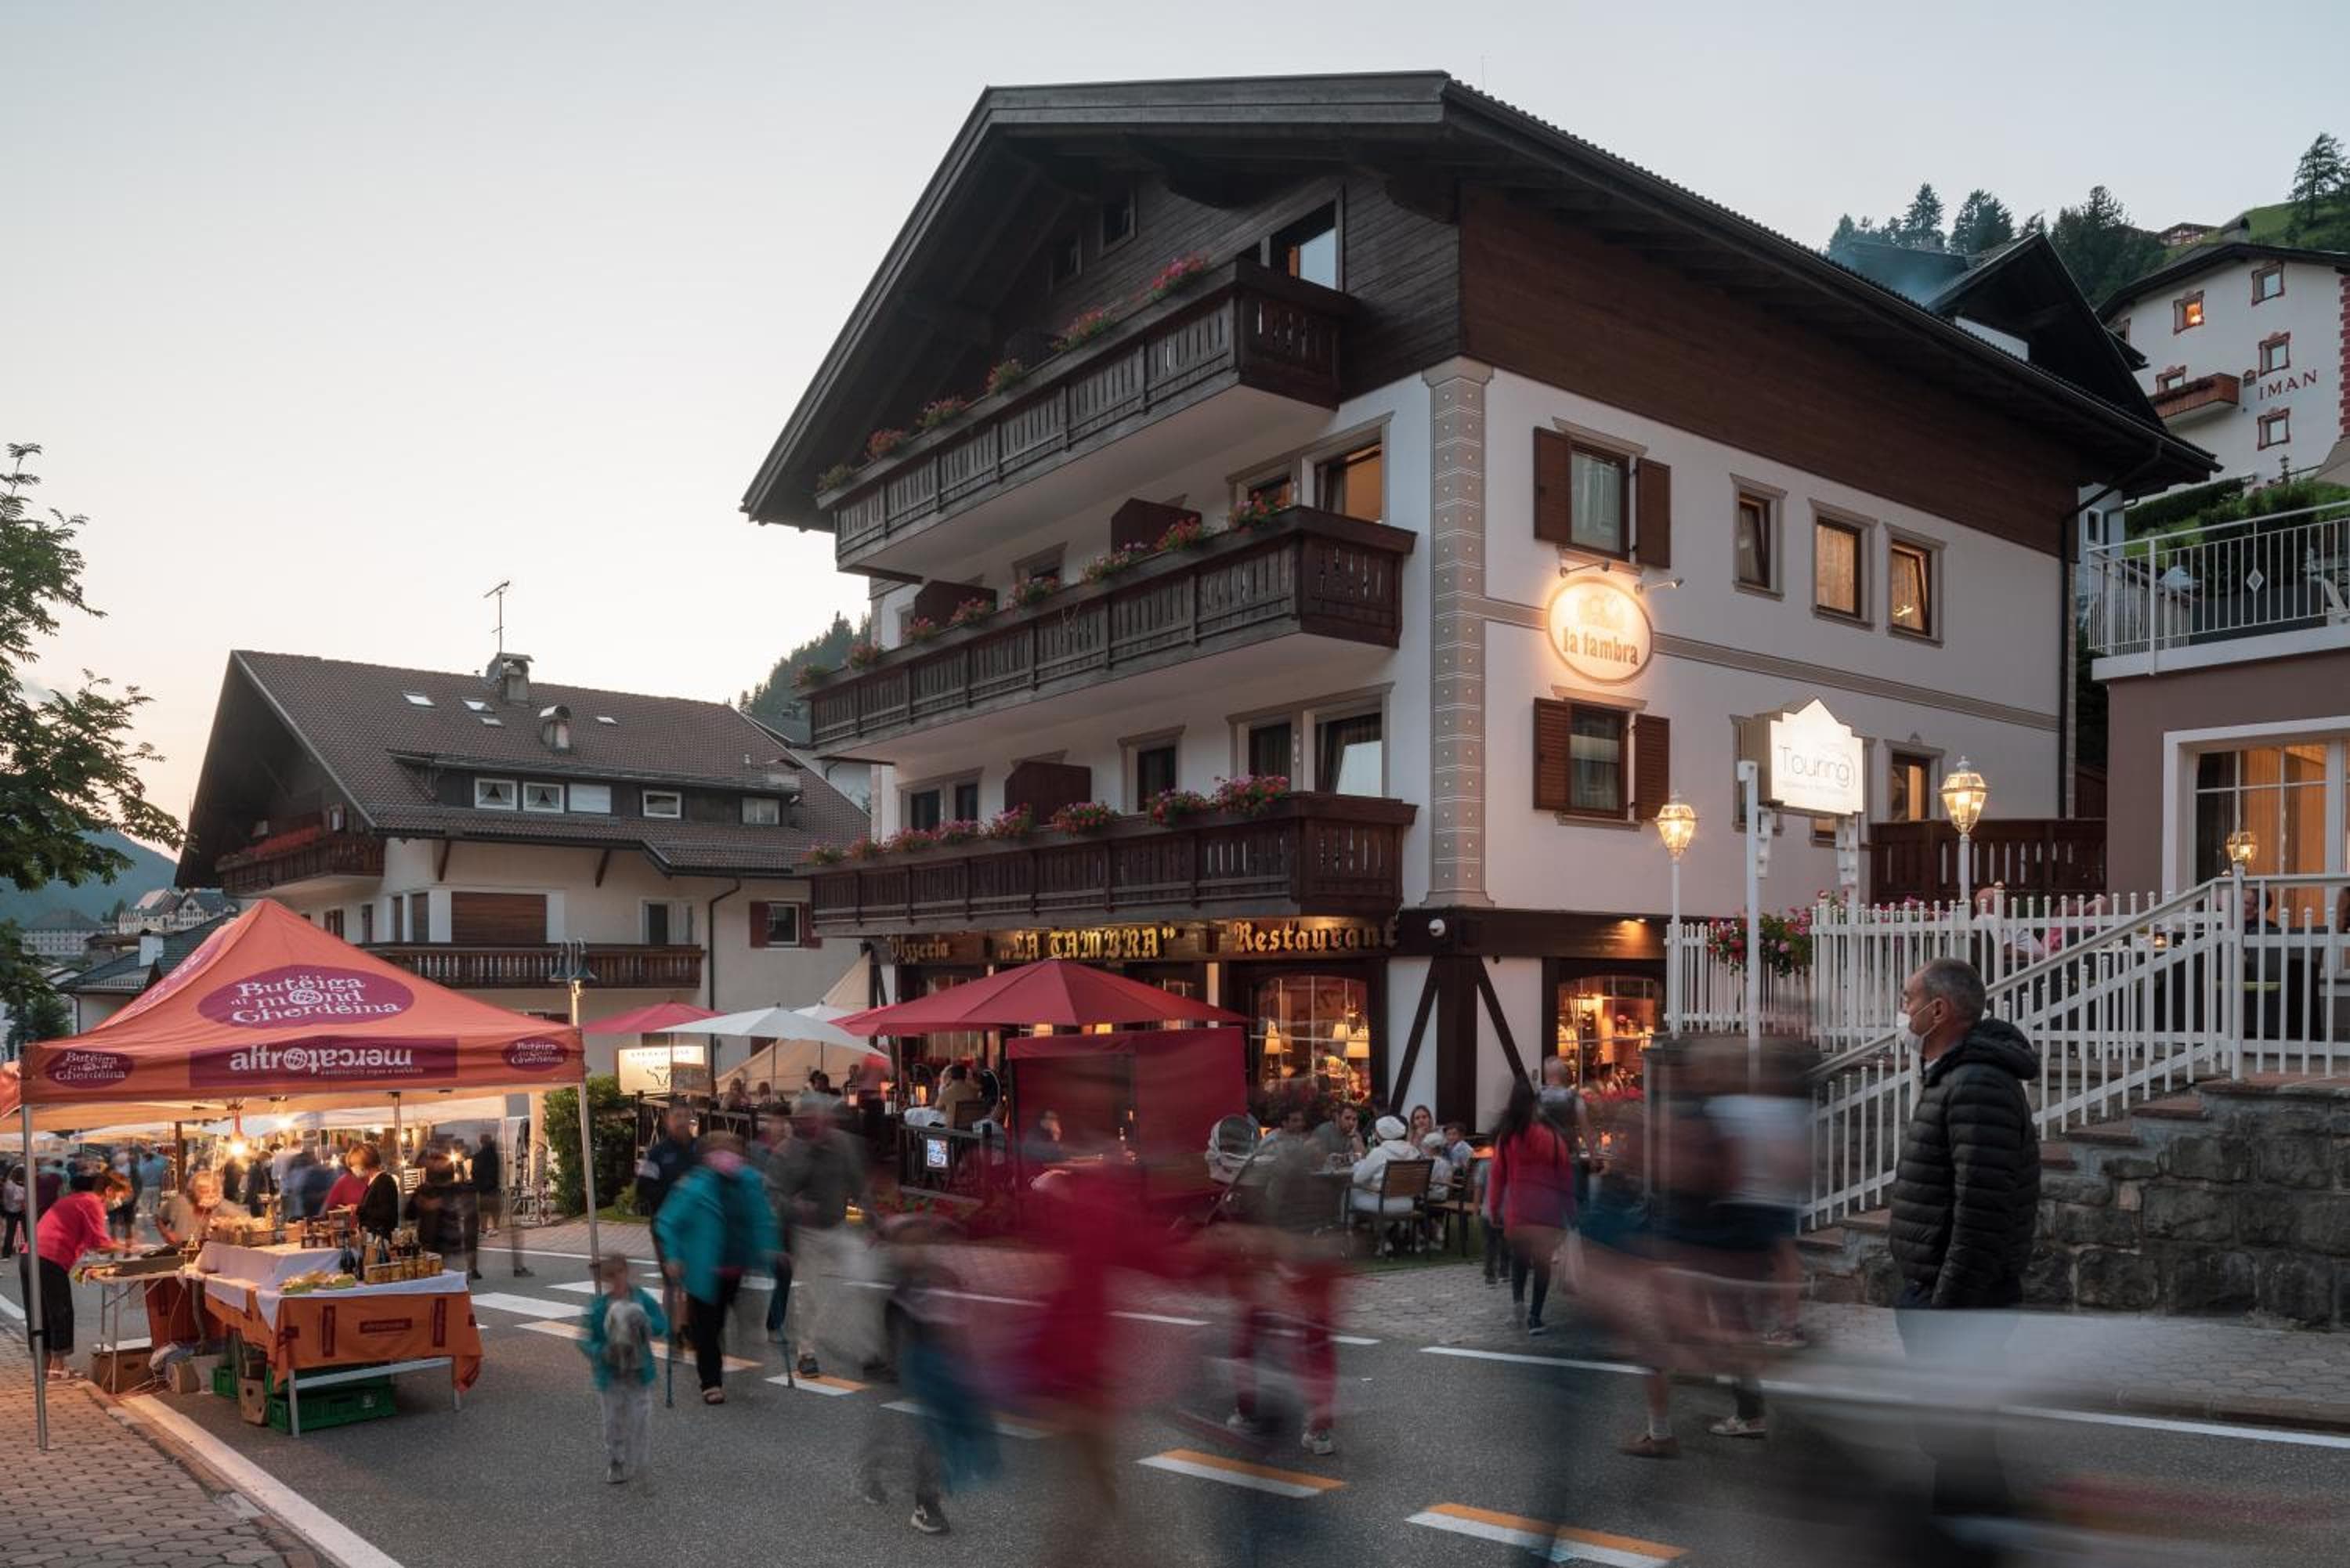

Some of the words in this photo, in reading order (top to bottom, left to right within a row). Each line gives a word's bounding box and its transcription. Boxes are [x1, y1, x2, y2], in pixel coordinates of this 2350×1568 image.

[2259, 369, 2317, 401] IMAN
[1563, 626, 1578, 654] la
[1582, 631, 1639, 667] tambra
[1234, 920, 1399, 953] Restaurant
